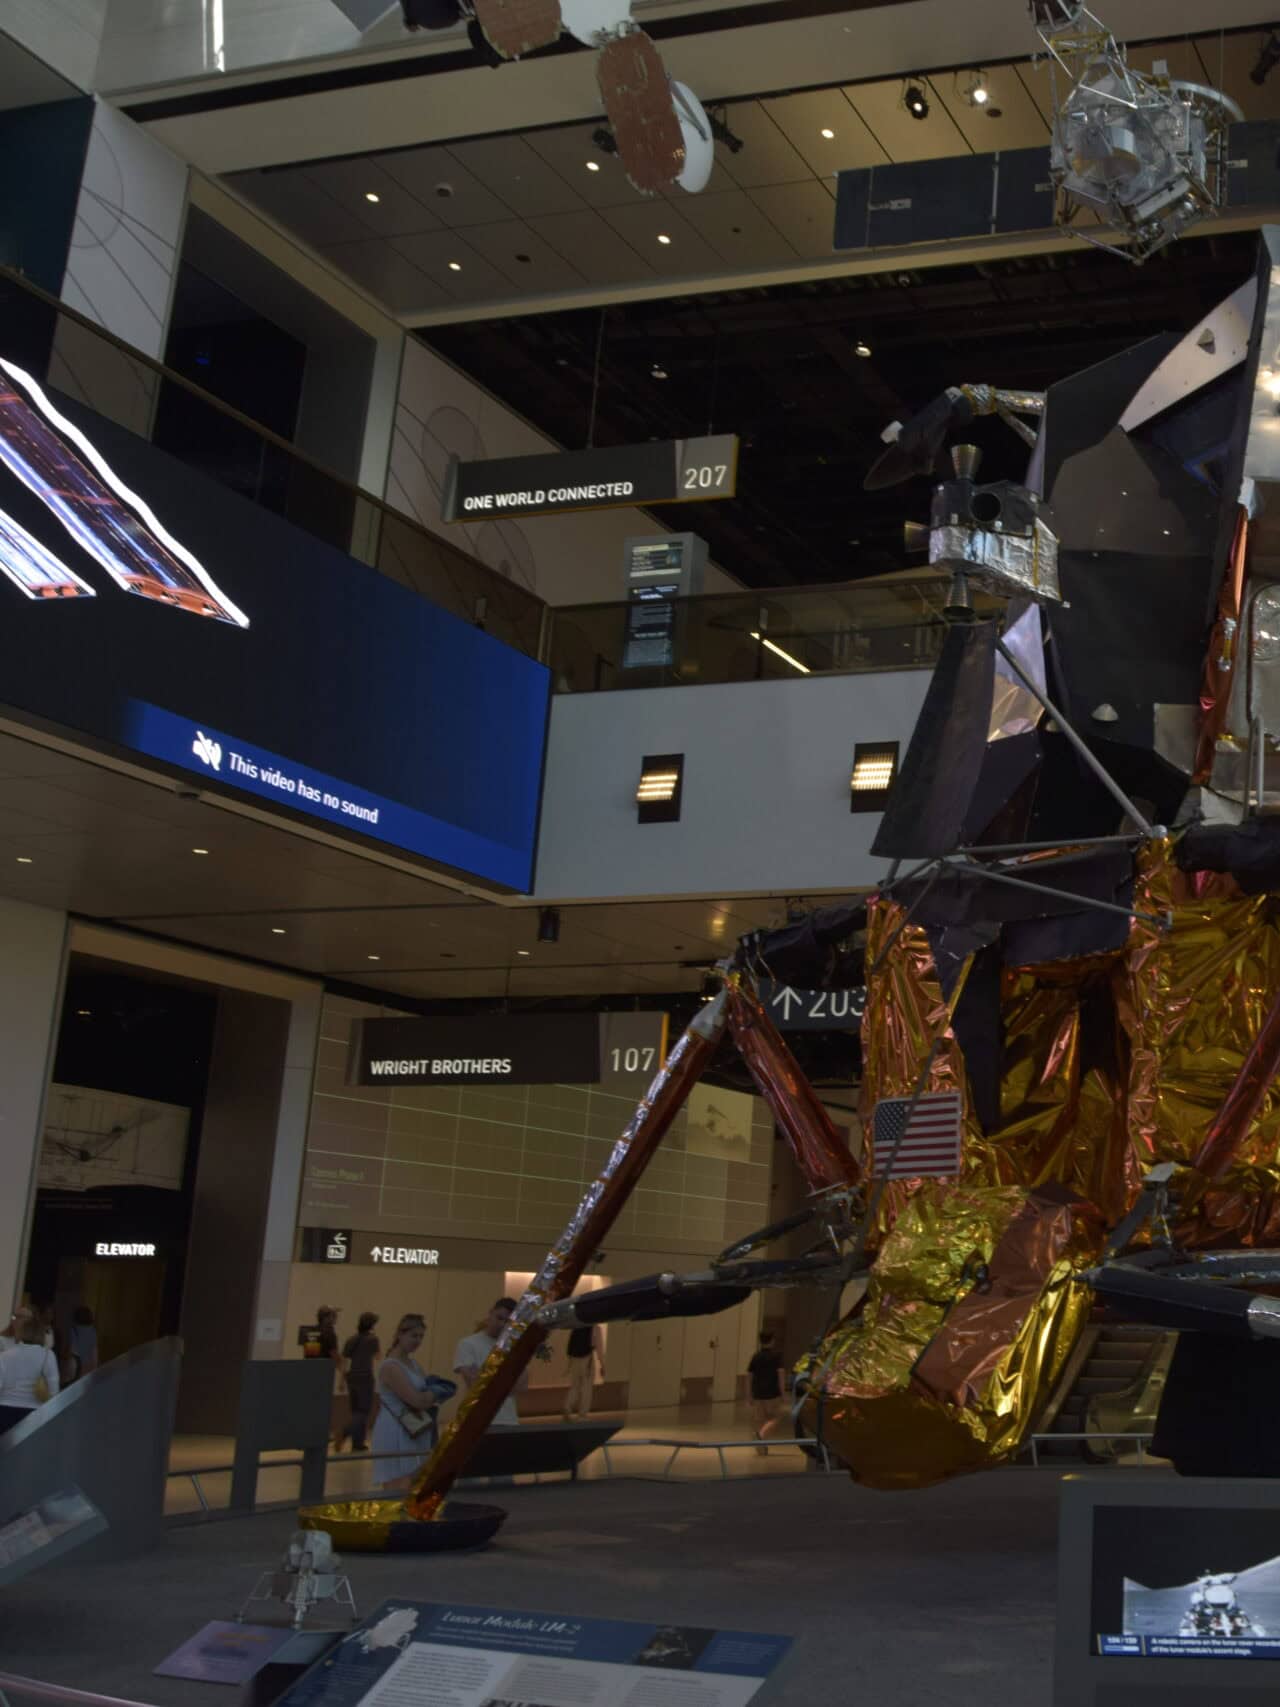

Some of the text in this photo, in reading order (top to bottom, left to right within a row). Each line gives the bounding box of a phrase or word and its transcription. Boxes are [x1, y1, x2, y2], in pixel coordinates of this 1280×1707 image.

[684, 465, 727, 489] 207
[464, 482, 633, 510] ONE WORLD CONNECTED
[229, 752, 379, 824] This video has no sound
[371, 1059, 512, 1075] WRIGHT BROTHERS
[611, 1047, 655, 1072] 107
[96, 1243, 155, 1256] ELEVATOR
[382, 1246, 440, 1265] ELEVATOR
